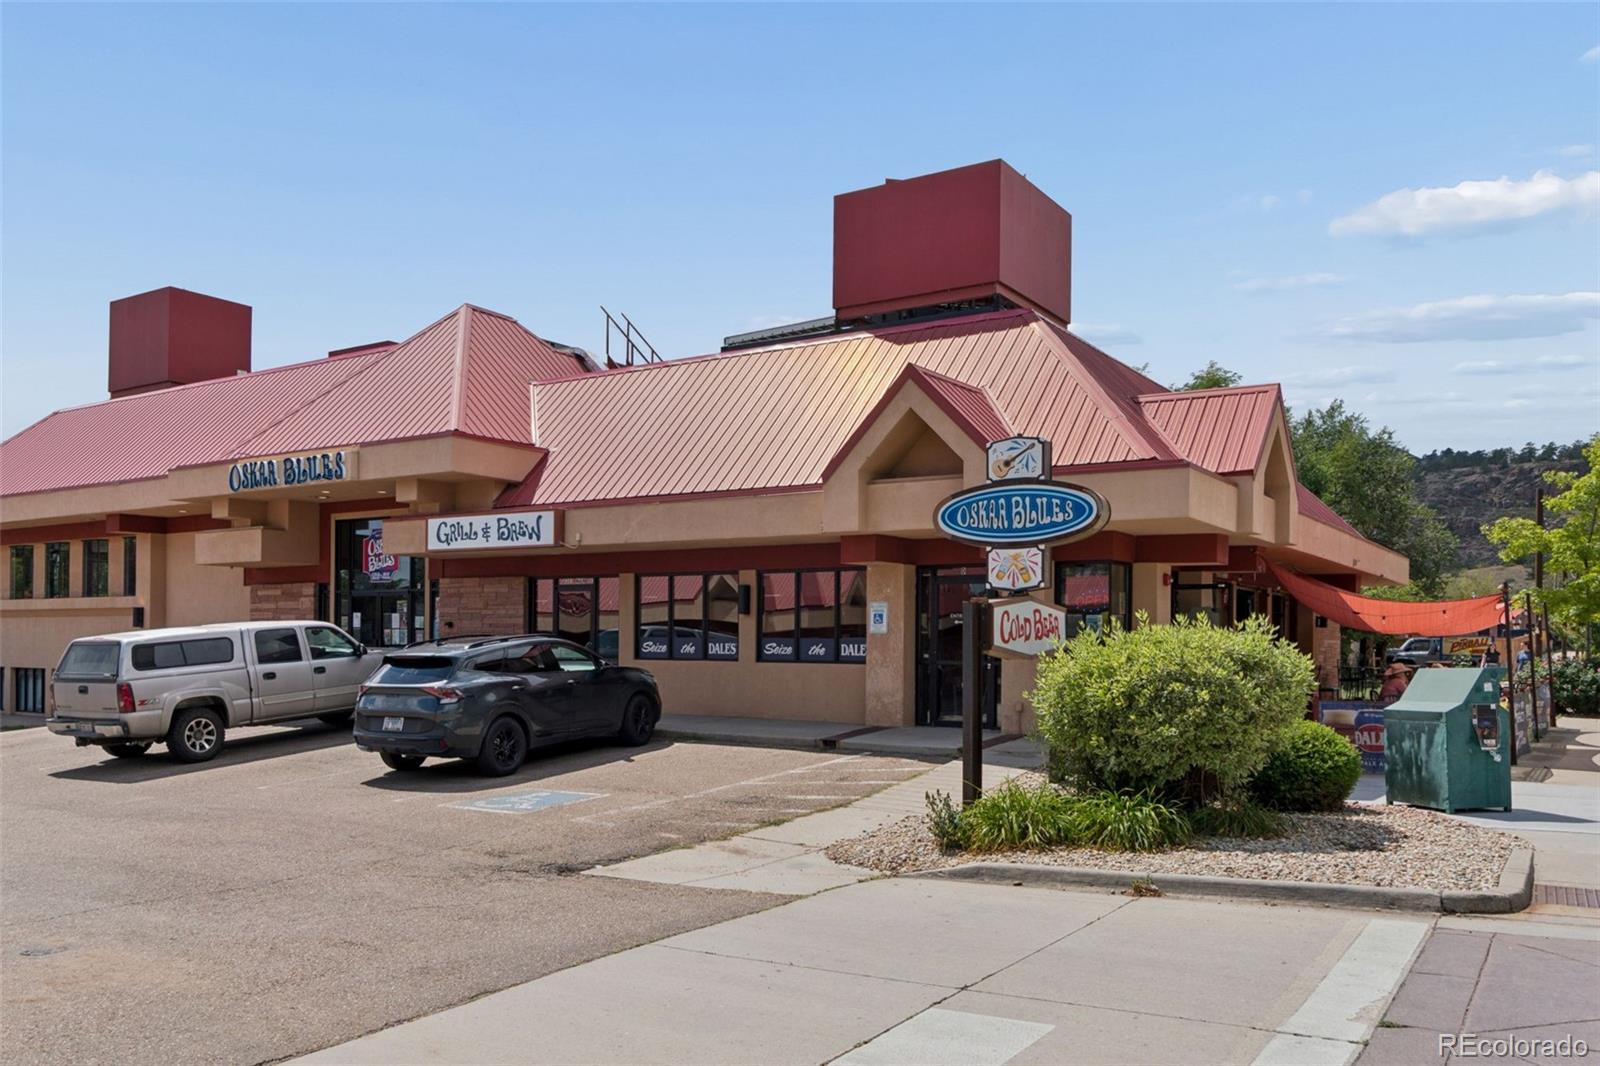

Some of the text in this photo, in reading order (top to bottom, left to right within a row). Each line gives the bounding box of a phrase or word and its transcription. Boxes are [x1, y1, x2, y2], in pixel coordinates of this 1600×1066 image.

[229, 451, 344, 492] OSKAR BLUES
[957, 496, 1074, 530] OSKAR BLUES
[436, 515, 543, 546] GRILL & BREW
[1000, 608, 1060, 644] COLD BEER
[641, 641, 668, 653] Seize
[680, 642, 696, 654] the
[763, 642, 793, 655] Seize
[808, 643, 826, 656] the
